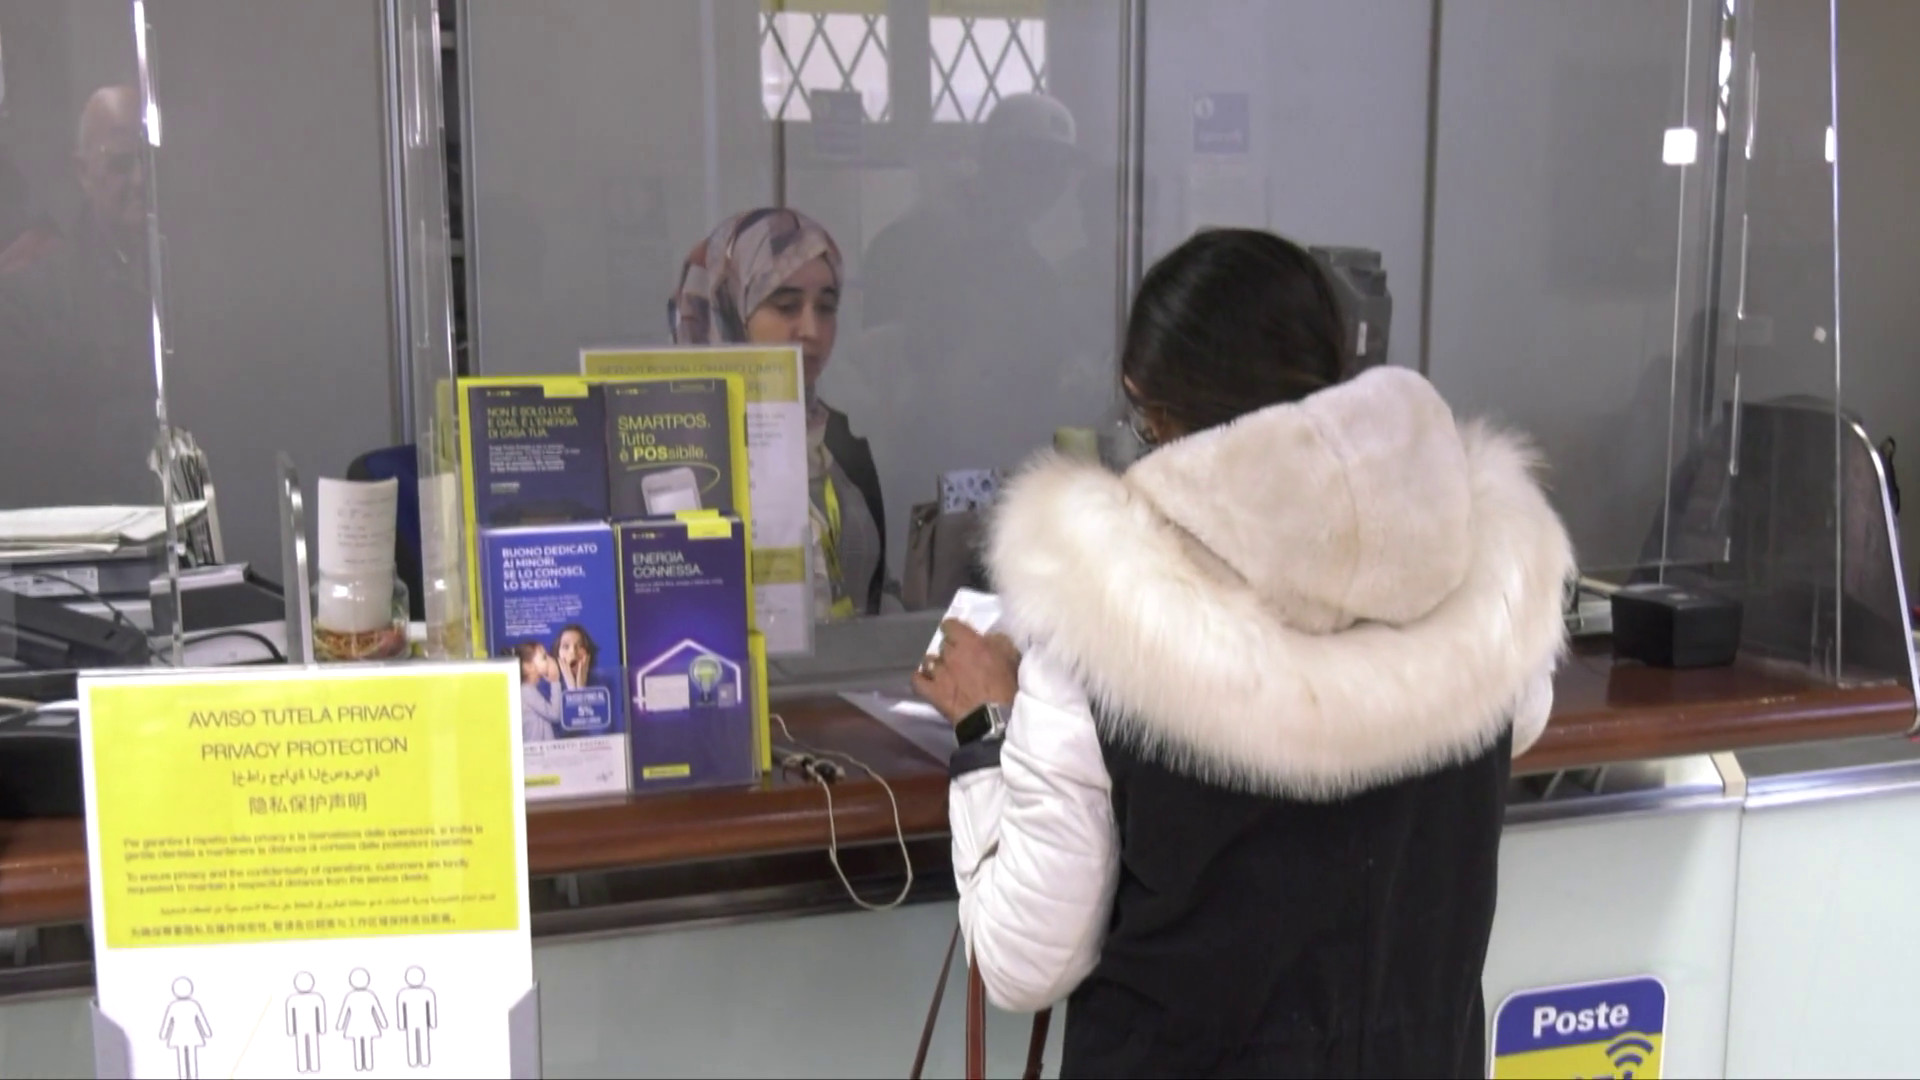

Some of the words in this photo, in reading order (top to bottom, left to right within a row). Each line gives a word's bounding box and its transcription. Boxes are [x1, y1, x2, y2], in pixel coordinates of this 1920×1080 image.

[618, 412, 711, 431] SMARTPOS.
[619, 431, 655, 447] Tutto
[620, 449, 628, 463] è
[633, 444, 708, 462] POSsibile.
[502, 547, 542, 558] BUONO
[544, 543, 598, 556] DEDICATO
[632, 550, 685, 565] ENERGIA
[502, 558, 513, 569] AI
[515, 557, 557, 569] MINORI.
[633, 563, 704, 579] CONNESSA.
[503, 568, 517, 580] SE
[518, 568, 533, 579] LO
[535, 565, 586, 578] CONOSCI,
[504, 579, 518, 591] LO
[520, 577, 561, 590] SCEGLI.
[189, 709, 256, 729] AVVISO
[260, 706, 332, 726] TUTELA
[337, 703, 417, 723] PRIVACY
[201, 742, 281, 762] PRIVACY
[286, 736, 409, 758] PROTECTION
[248, 791, 368, 816] 隐私保护声明
[1532, 1001, 1629, 1039] Poste
